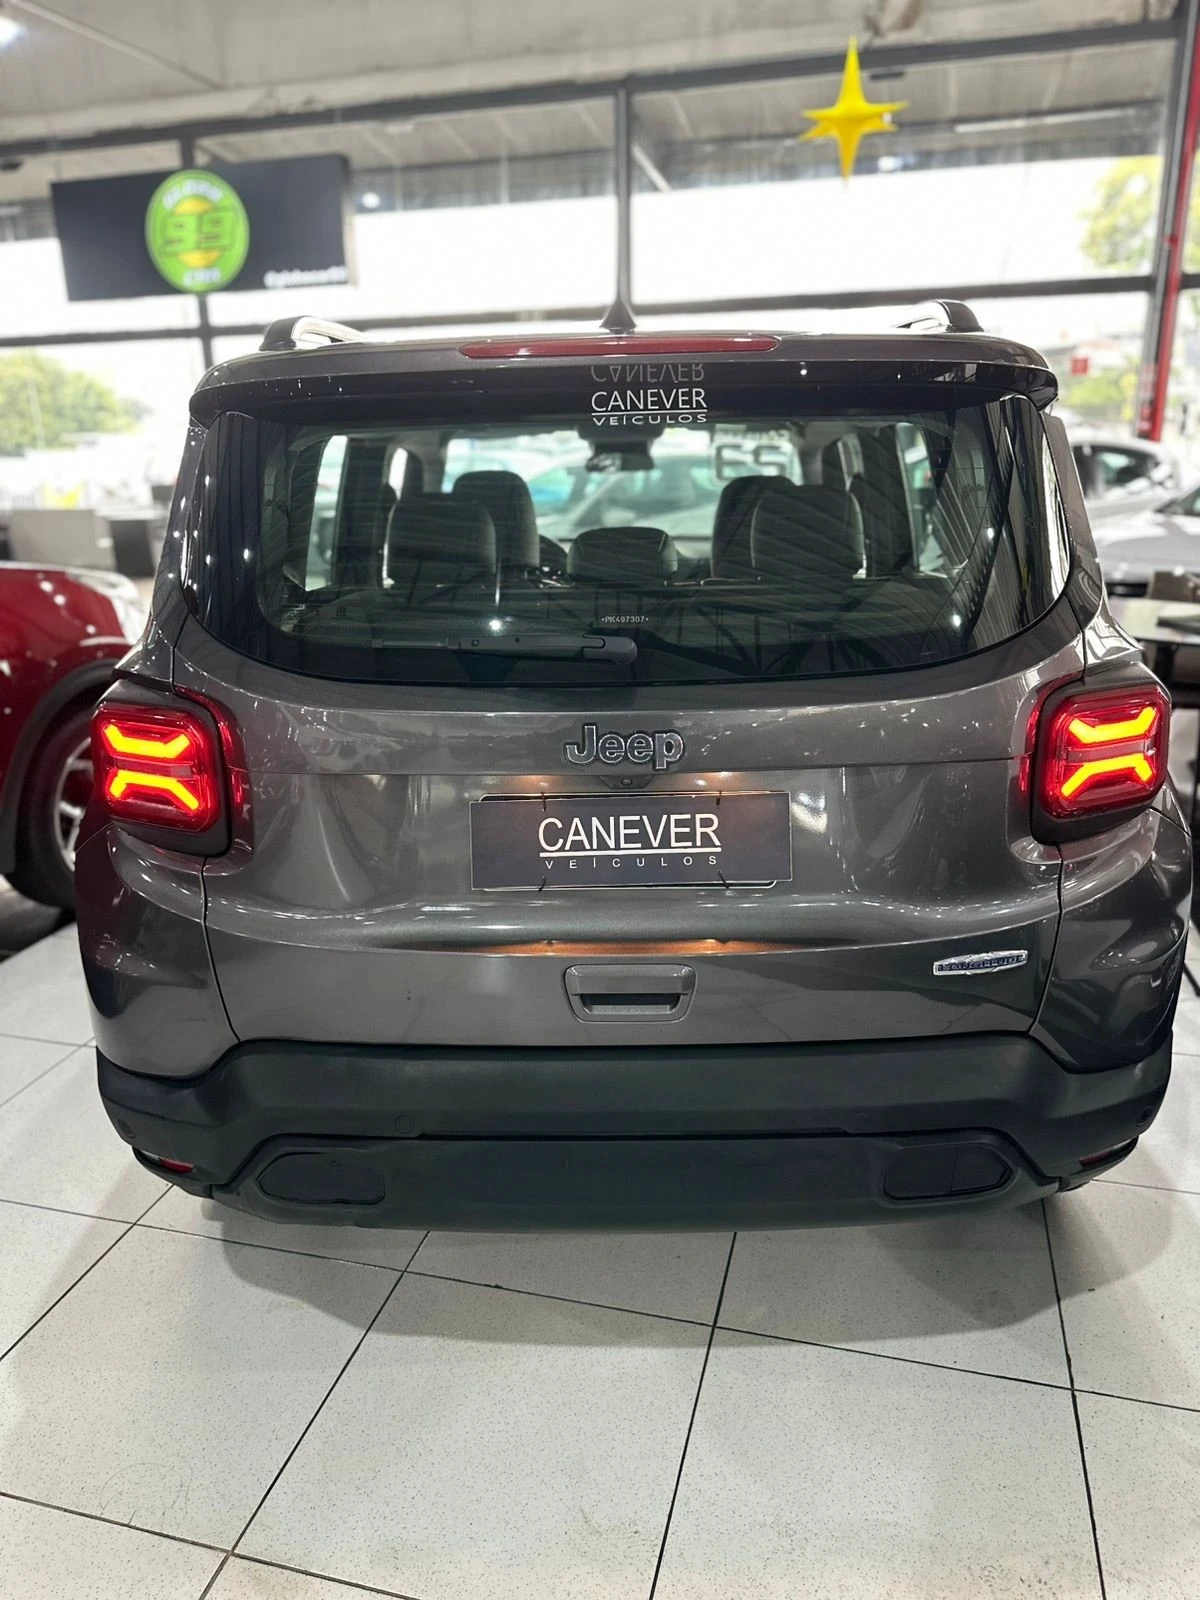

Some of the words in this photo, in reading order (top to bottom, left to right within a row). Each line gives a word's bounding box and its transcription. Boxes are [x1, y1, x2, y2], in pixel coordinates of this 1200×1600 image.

[591, 388, 707, 411] CANEVER
[592, 414, 707, 426] VEÍCULOS
[564, 722, 685, 769] Jeep
[538, 813, 721, 851] CANEVER
[545, 855, 717, 870] VEÍCULOS
